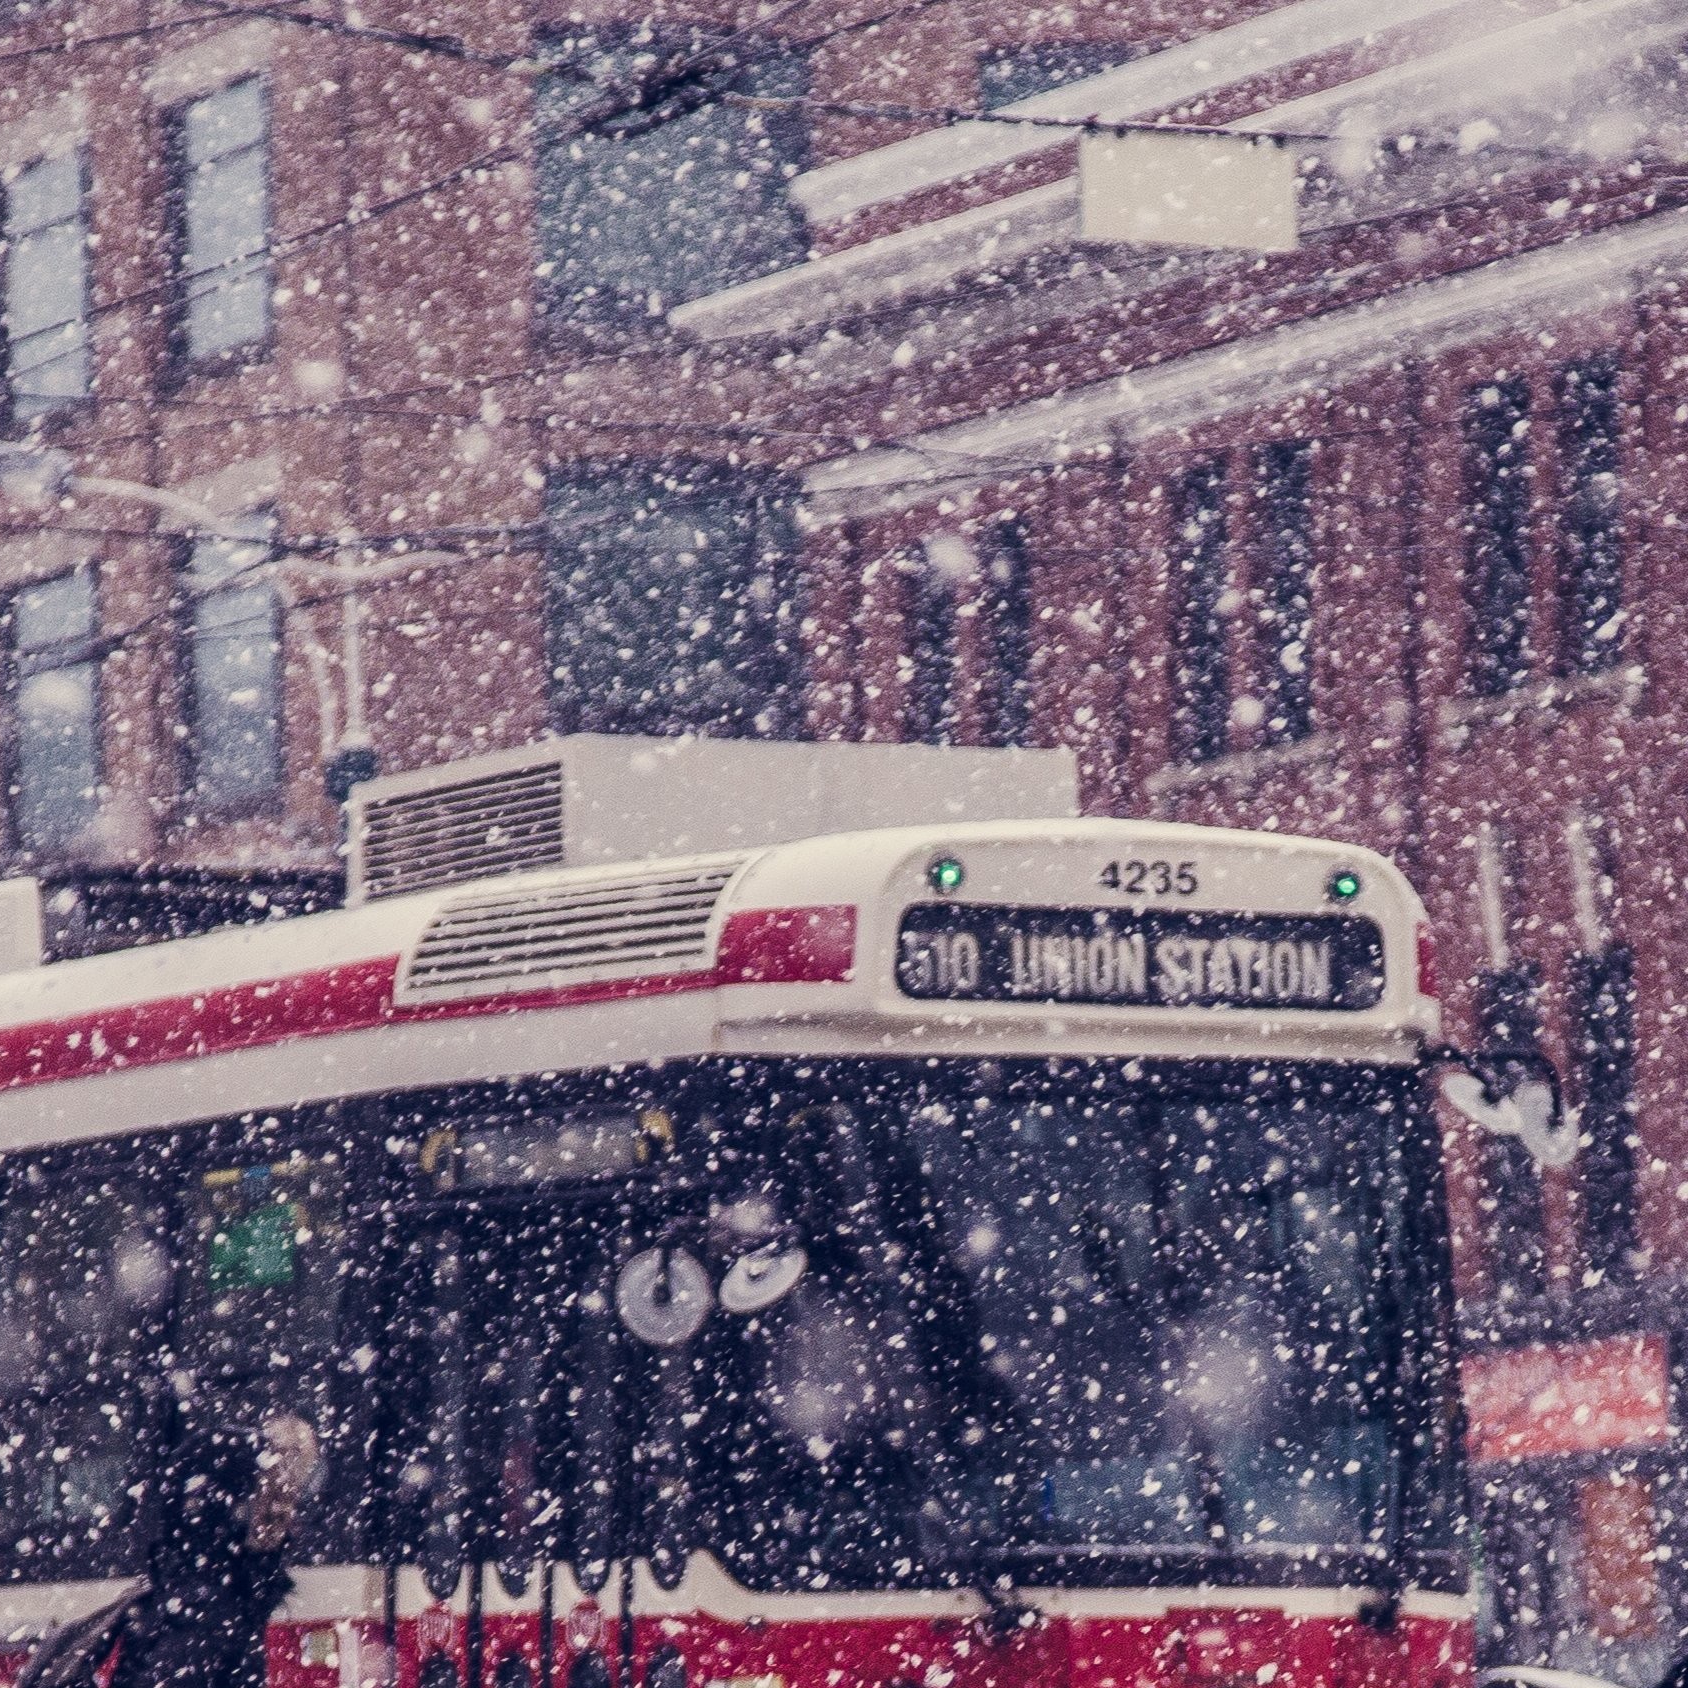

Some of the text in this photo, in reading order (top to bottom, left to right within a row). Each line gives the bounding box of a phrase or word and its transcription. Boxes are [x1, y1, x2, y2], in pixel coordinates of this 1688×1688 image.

[1098, 860, 1199, 896] 4235
[1011, 930, 1146, 994] UNION
[1155, 933, 1331, 998] STATION
